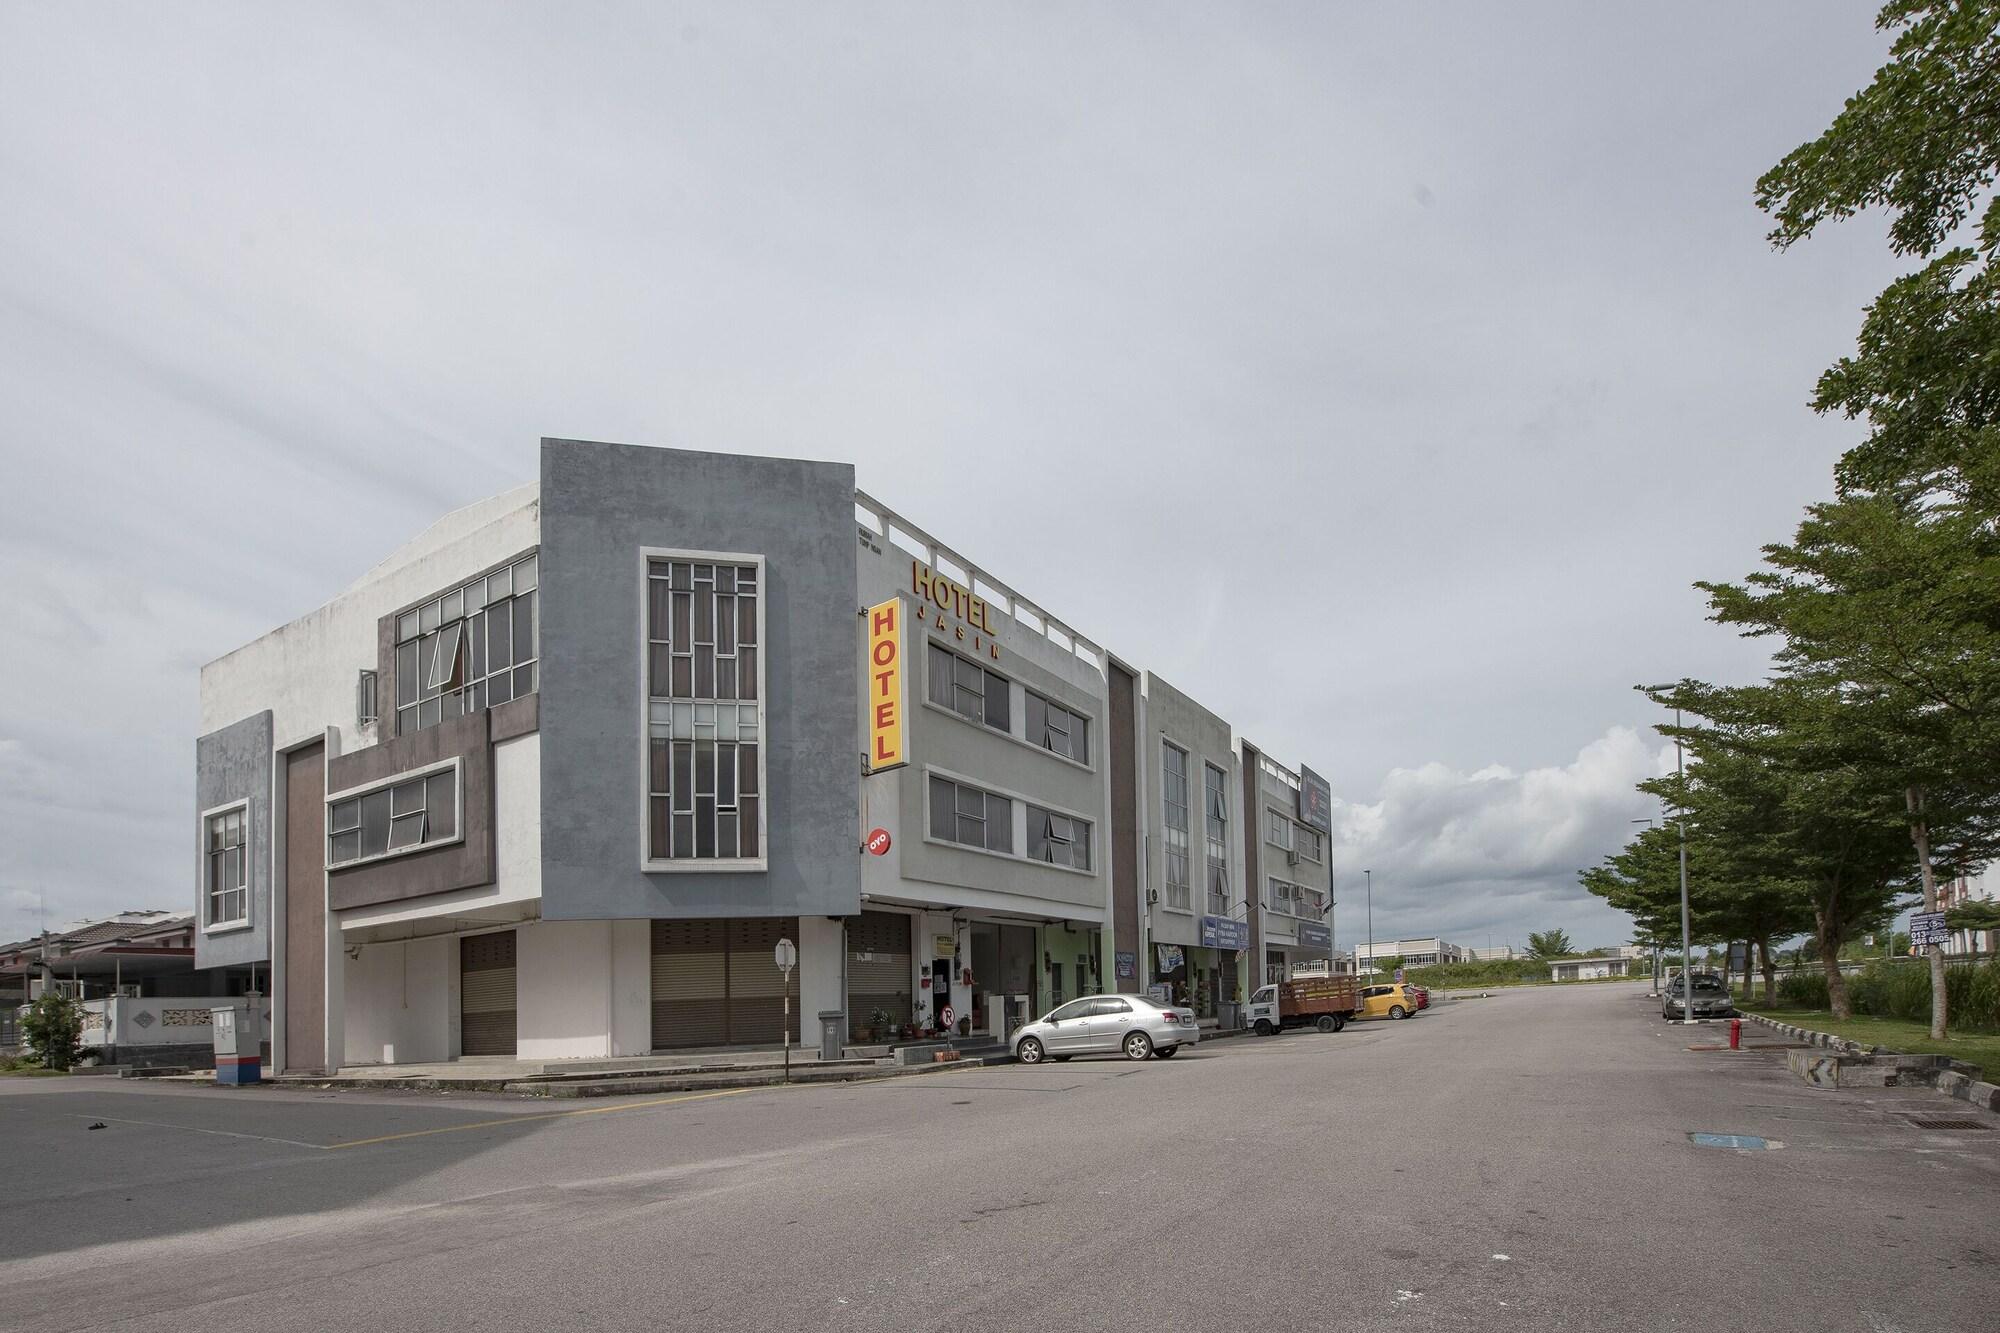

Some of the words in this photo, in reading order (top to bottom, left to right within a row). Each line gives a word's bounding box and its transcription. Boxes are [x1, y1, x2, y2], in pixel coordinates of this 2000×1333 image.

[912, 560, 997, 636] HOTEL
[917, 605, 1000, 660] JASIN
[873, 607, 896, 762] HOTEL
[870, 834, 886, 850] OYO
[1928, 935, 1950, 943] 0505
